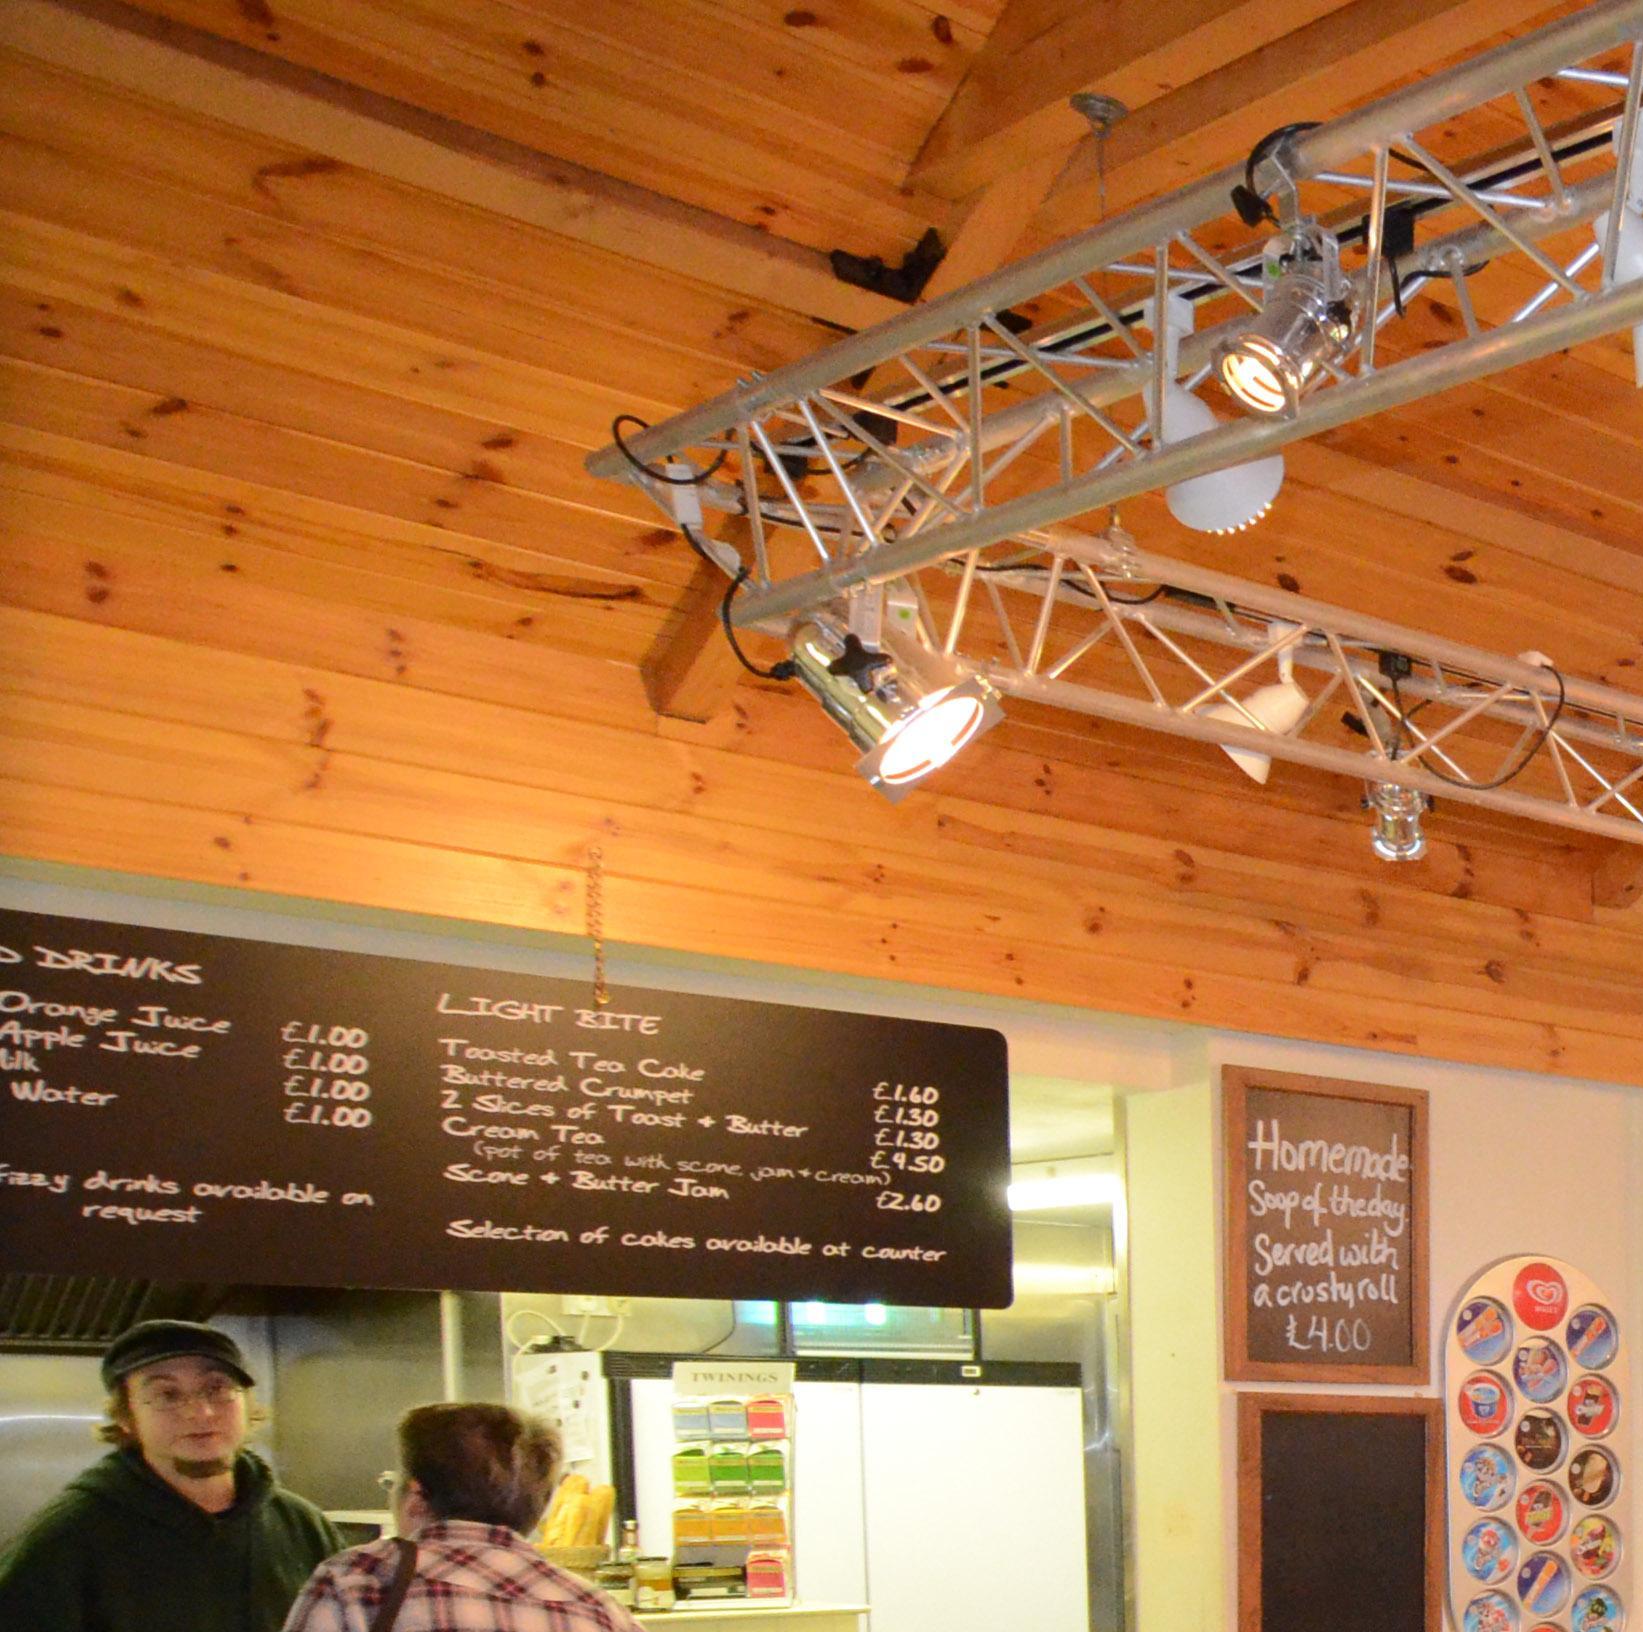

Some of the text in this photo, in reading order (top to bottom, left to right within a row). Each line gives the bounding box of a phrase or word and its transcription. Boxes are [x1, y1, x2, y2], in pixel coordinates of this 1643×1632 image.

[33, 944, 203, 985] DRINKS
[0, 990, 369, 1049] Orange Juice £1.00
[437, 992, 663, 1036] LIGHT BITE
[0, 1019, 370, 1076] Apple Juice £1.00
[437, 1037, 940, 1105] Toasted Tea Cake £1.60
[0, 1047, 371, 1102] ilk £1.00
[439, 1063, 940, 1127] Buttered Crumpet £1.30
[11, 1078, 373, 1129] Water £1.00
[440, 1088, 463, 1110] 2
[472, 1093, 556, 1118] Slices
[566, 1101, 598, 1121] of
[607, 1103, 688, 1129] Toast
[725, 1113, 810, 1139] Butter
[873, 1127, 941, 1151] £1.30
[441, 1115, 541, 1142] Cream
[550, 1124, 607, 1145] Tea
[1247, 1118, 1411, 1183] Homemade
[532, 1143, 562, 1162] of
[572, 1148, 613, 1167] tea
[623, 1151, 672, 1172] with
[83, 1169, 182, 1196] drinks
[192, 1179, 331, 1205] available
[341, 1191, 375, 1207] on
[443, 1162, 531, 1187] Scone
[569, 1169, 660, 1195] Butter
[667, 1176, 731, 1200] Jam
[875, 1190, 942, 1213] £2.60
[1301, 1181, 1329, 1228] of
[81, 1203, 204, 1225] request
[446, 1218, 948, 1263] Selection of cakes available at counter
[1253, 1226, 1400, 1277] Served with
[1253, 1270, 1400, 1310] a crusty roll
[1286, 1313, 1372, 1353] £4.00
[691, 1370, 780, 1385] TWININGS
